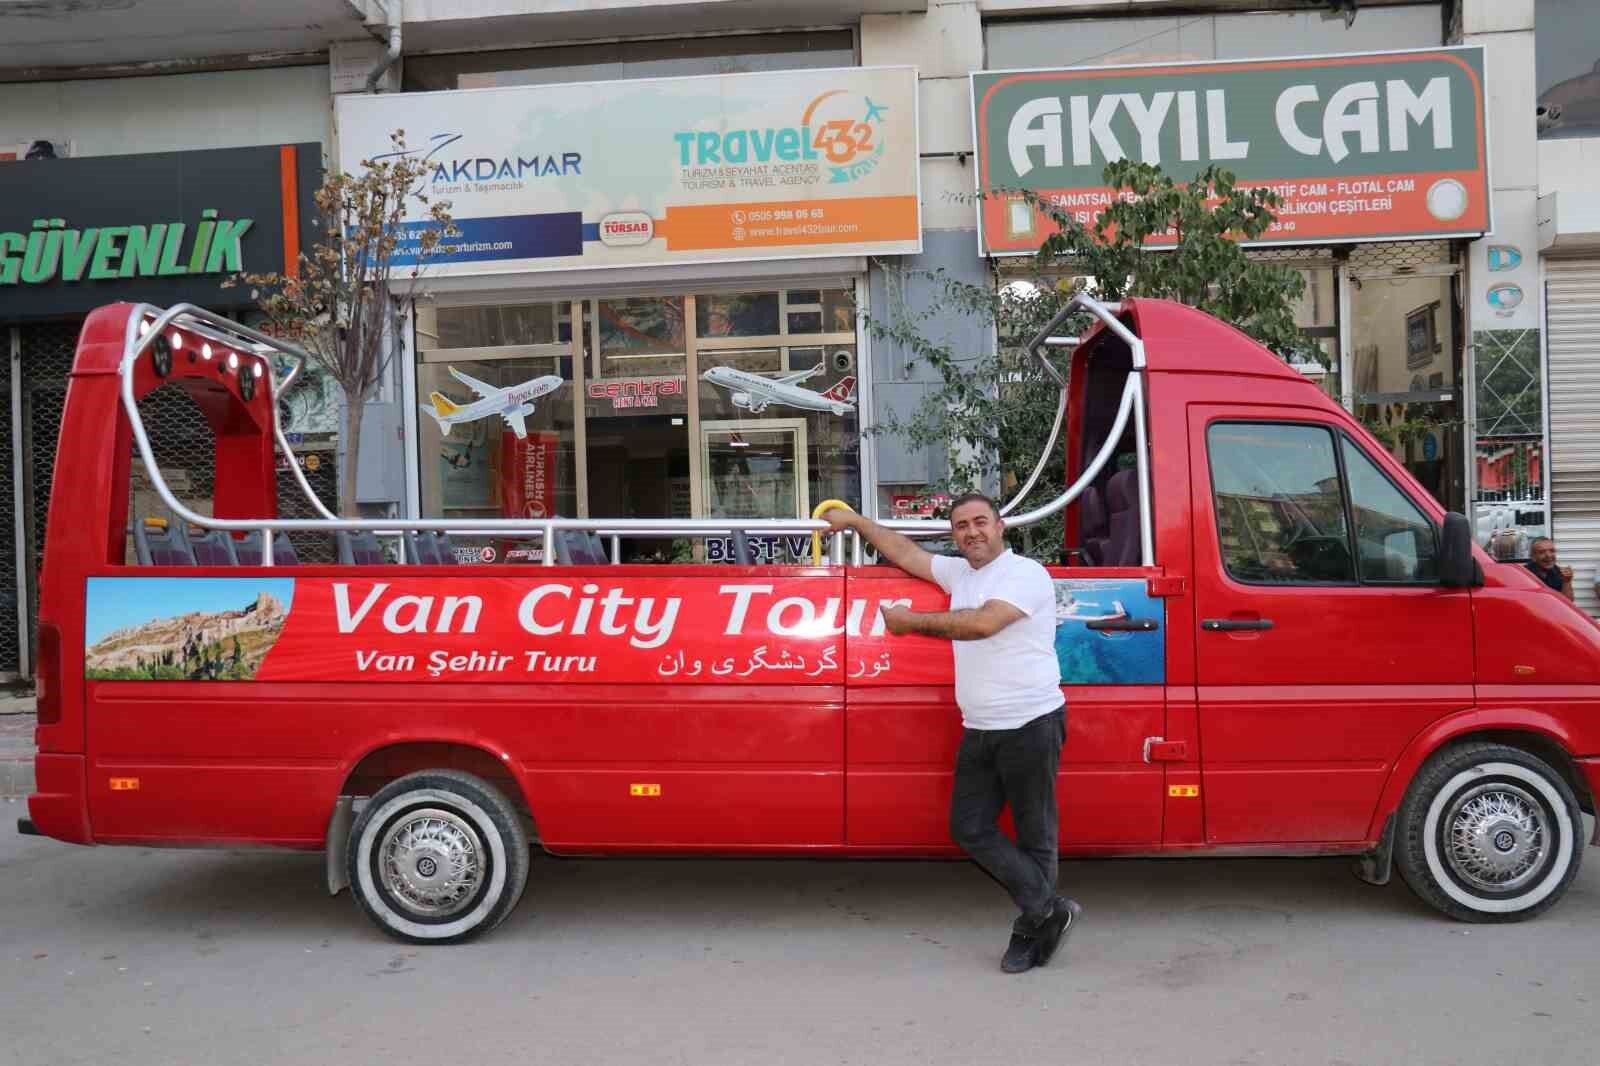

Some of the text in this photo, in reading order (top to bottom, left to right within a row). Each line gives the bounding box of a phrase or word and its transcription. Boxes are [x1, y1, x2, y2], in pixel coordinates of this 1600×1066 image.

[1007, 76, 1453, 178] AKYIL CAM
[432, 152, 582, 183] AKDAMAR
[1299, 183, 1328, 197] CAM
[1337, 179, 1385, 195] FLOTAL
[1386, 179, 1415, 193] CAM
[1328, 195, 1392, 215] ÇEŞİTLERİ
[603, 220, 649, 234] TÜRSAB
[0, 207, 253, 284] GÜVENLİK
[588, 378, 683, 398] central
[525, 443, 536, 500] AIRLINES
[535, 444, 546, 500] TURKISH
[705, 536, 780, 561] BEST
[331, 583, 913, 649] Van City Tour
[354, 649, 598, 678] Van Şehir Turu
[658, 649, 702, 677] وان
[847, 652, 891, 678] تور
